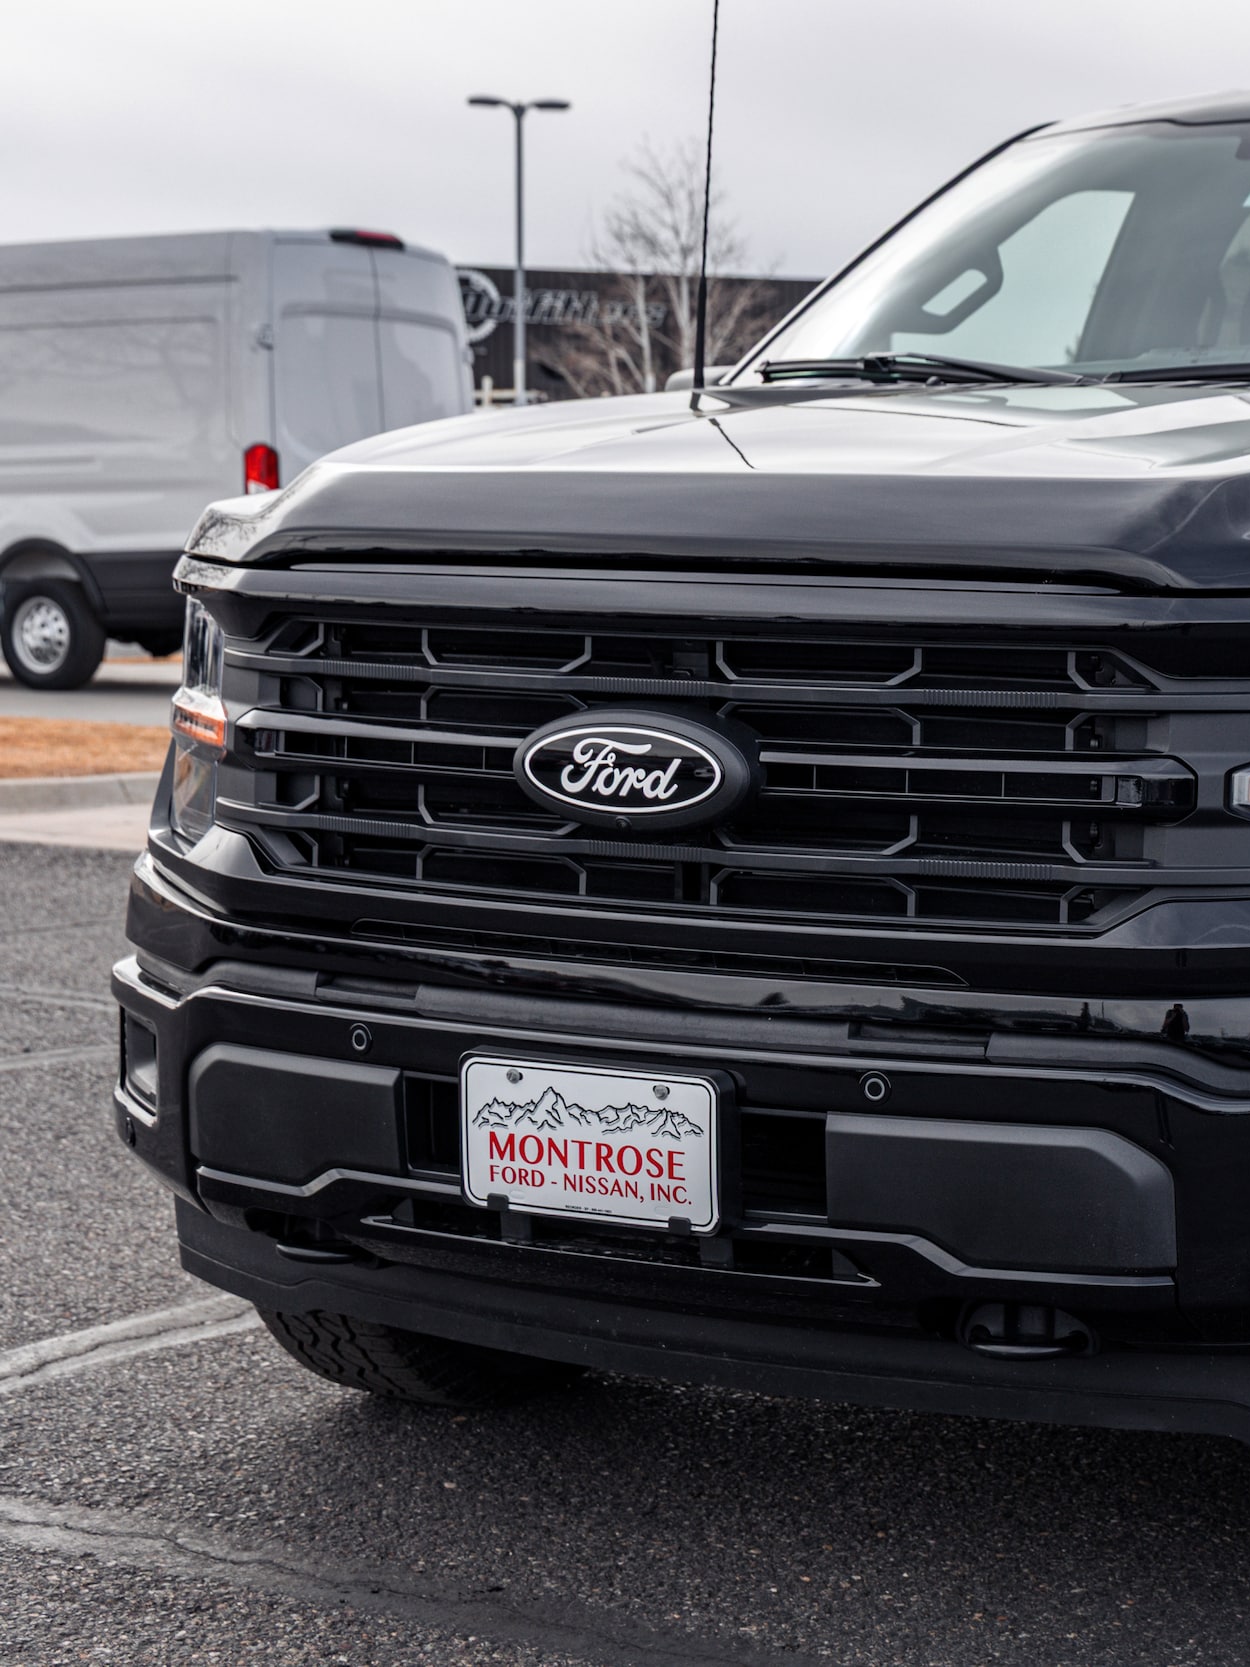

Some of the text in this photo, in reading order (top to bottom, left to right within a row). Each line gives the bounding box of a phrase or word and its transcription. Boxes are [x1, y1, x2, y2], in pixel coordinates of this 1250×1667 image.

[560, 737, 682, 800] Ford
[488, 1130, 686, 1181] MONTROSE
[489, 1164, 545, 1188] FORD
[563, 1173, 645, 1203] NISSAN,
[650, 1183, 693, 1206] INC.
